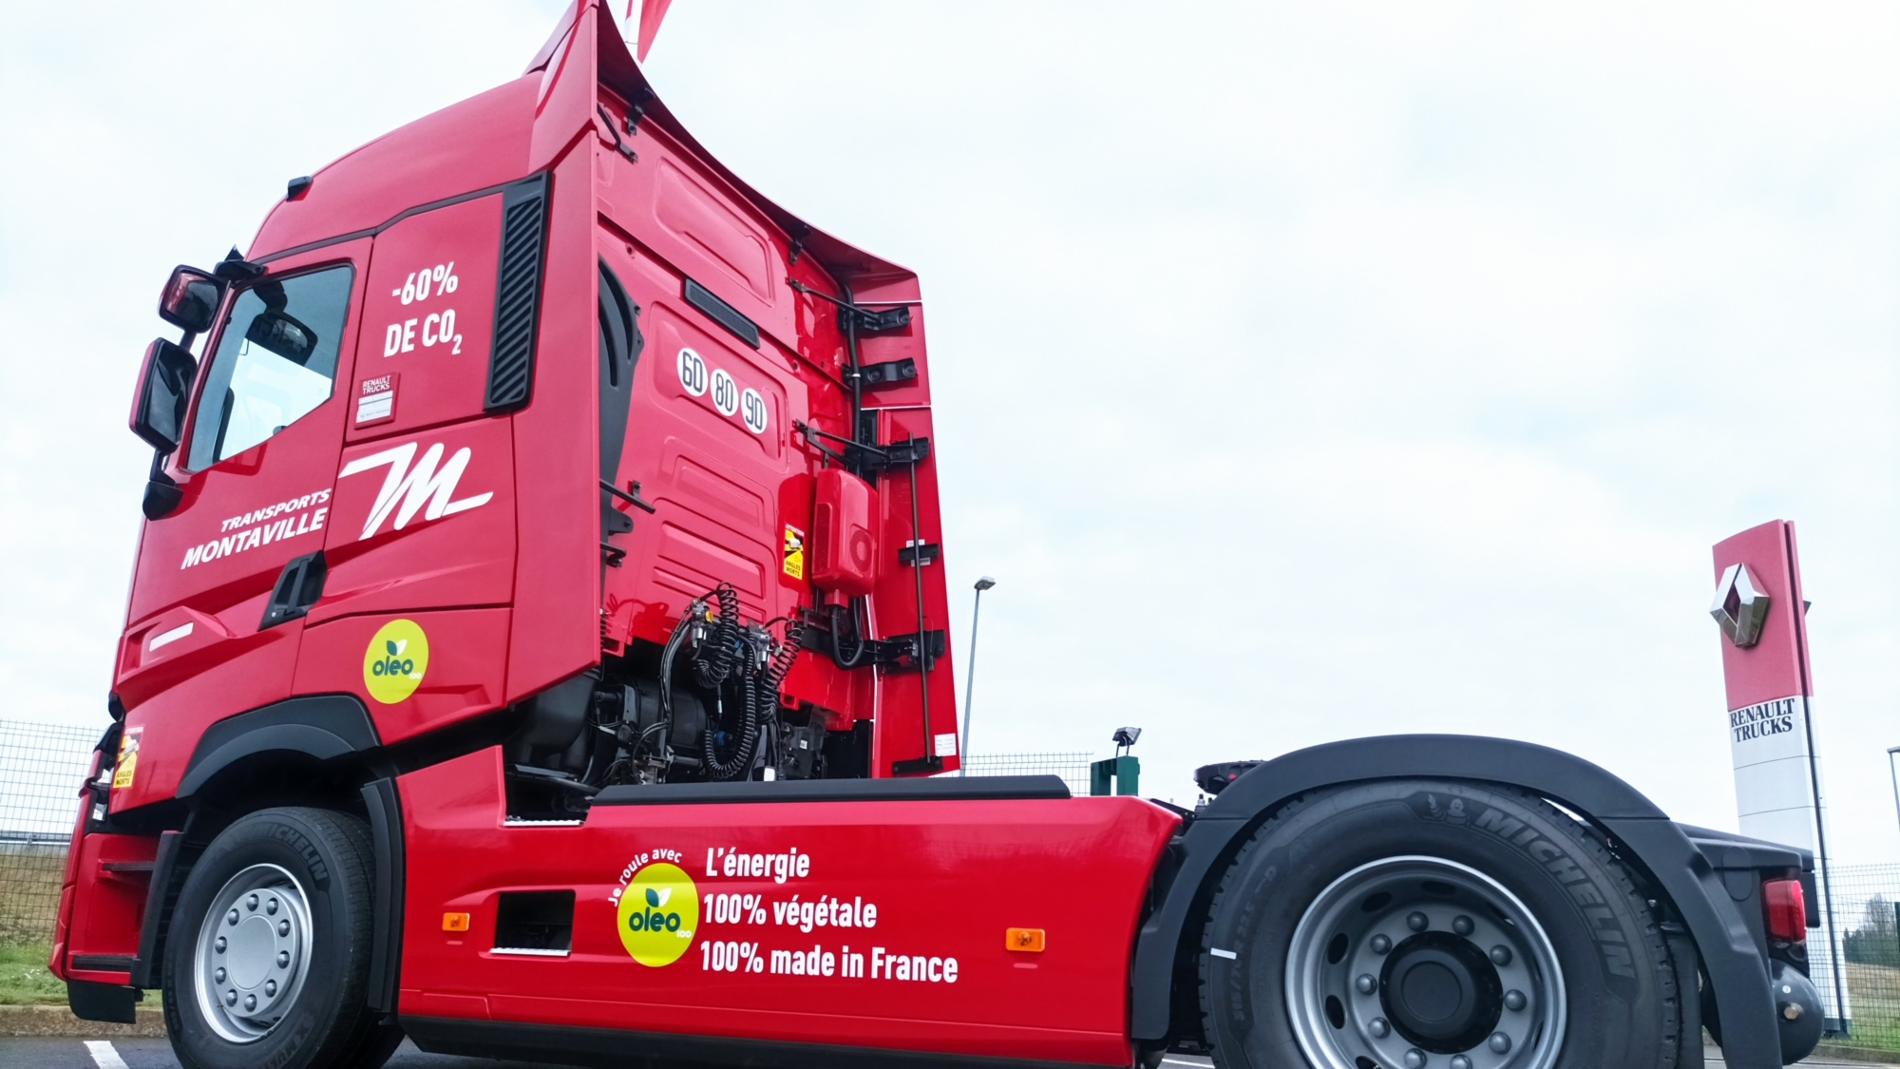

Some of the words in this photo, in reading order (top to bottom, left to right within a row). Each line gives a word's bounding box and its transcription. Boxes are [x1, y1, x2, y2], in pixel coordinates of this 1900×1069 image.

[392, 261, 459, 306] -60%
[383, 318, 418, 358] DE
[682, 351, 703, 393] 60
[716, 373, 734, 412] 80
[745, 391, 763, 431] 90
[220, 488, 331, 533] TRANSPORTS
[180, 507, 328, 570] MONTAVILLE
[372, 655, 414, 676] oleo
[1730, 698, 1795, 728] RENAULT
[1734, 716, 1793, 742] TRUCKS
[608, 887, 622, 908] Je
[619, 852, 649, 886] roule
[652, 848, 682, 863] avec
[706, 847, 810, 884] L'énergie
[704, 893, 767, 925] 100%
[773, 895, 877, 933] végétale
[1475, 807, 1637, 980] MICHELIN
[629, 907, 681, 932] oleo
[701, 940, 764, 973] 100%
[770, 945, 835, 976] made
[841, 946, 864, 978] in
[871, 947, 958, 983] France
